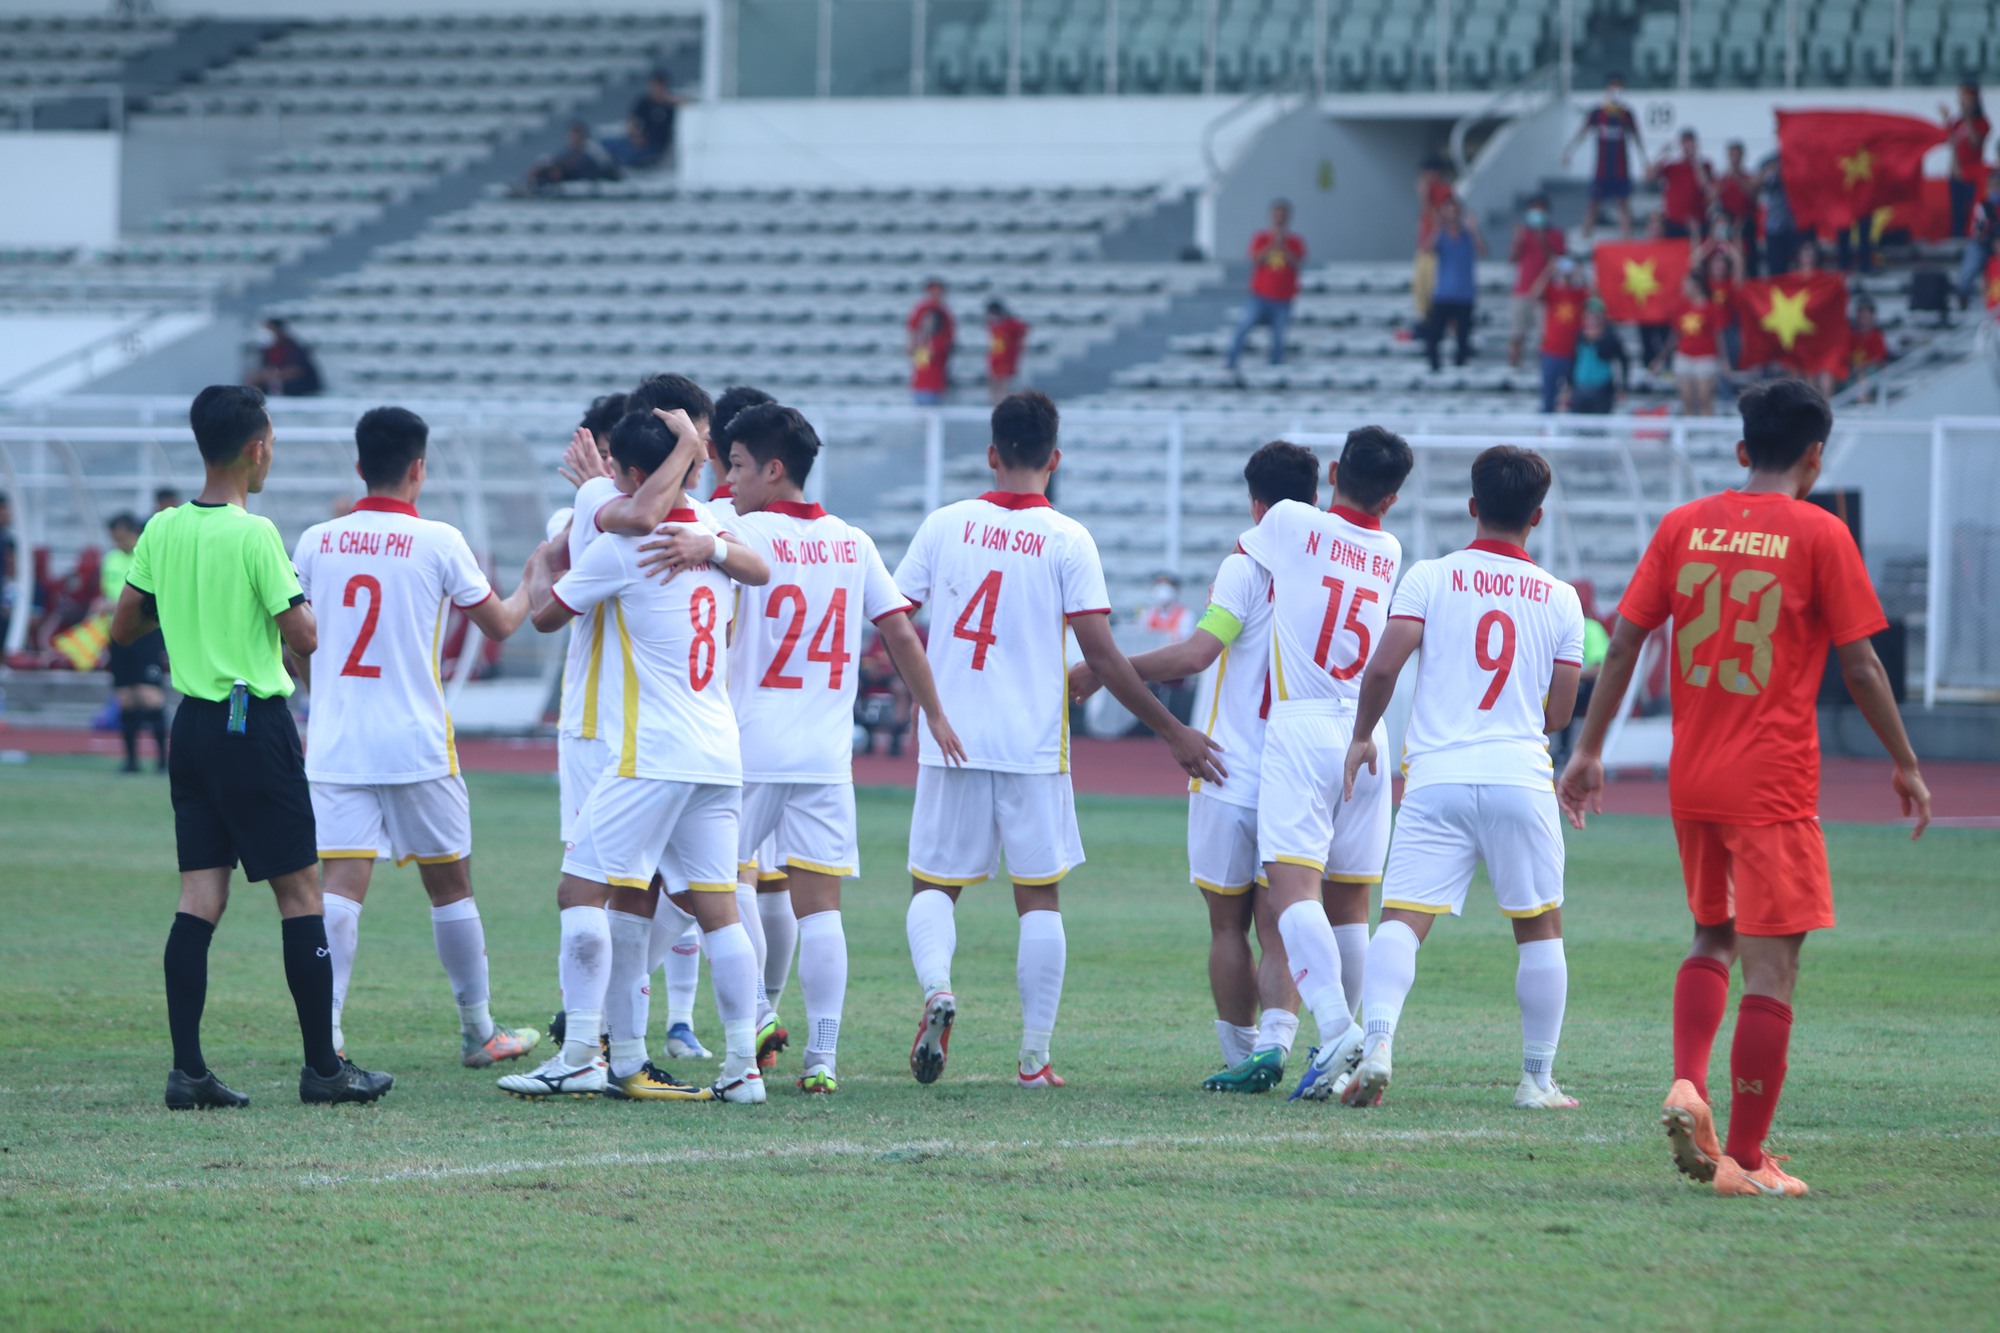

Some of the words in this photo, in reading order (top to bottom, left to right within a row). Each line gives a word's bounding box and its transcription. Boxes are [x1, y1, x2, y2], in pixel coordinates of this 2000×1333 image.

[320, 531, 334, 554] H.
[339, 531, 383, 556] CHAU
[385, 533, 414, 558] PHI
[772, 538, 797, 564] NG.
[830, 540, 857, 564] VIET
[963, 520, 976, 545] V.
[981, 524, 1010, 551] VAN
[1011, 530, 1046, 558] SON
[1330, 539, 1367, 572] DINH
[1452, 569, 1468, 592] N.
[1473, 570, 1515, 598] QUOC
[1518, 575, 1553, 605] VIET
[1688, 527, 1789, 559] K.Z.HEIN
[340, 573, 382, 679] 2
[688, 585, 717, 692] 8
[759, 584, 850, 690] 24
[953, 570, 1003, 671] 4
[1313, 575, 1379, 681] 15
[1475, 609, 1516, 711] 9
[1676, 561, 1782, 696] 23
